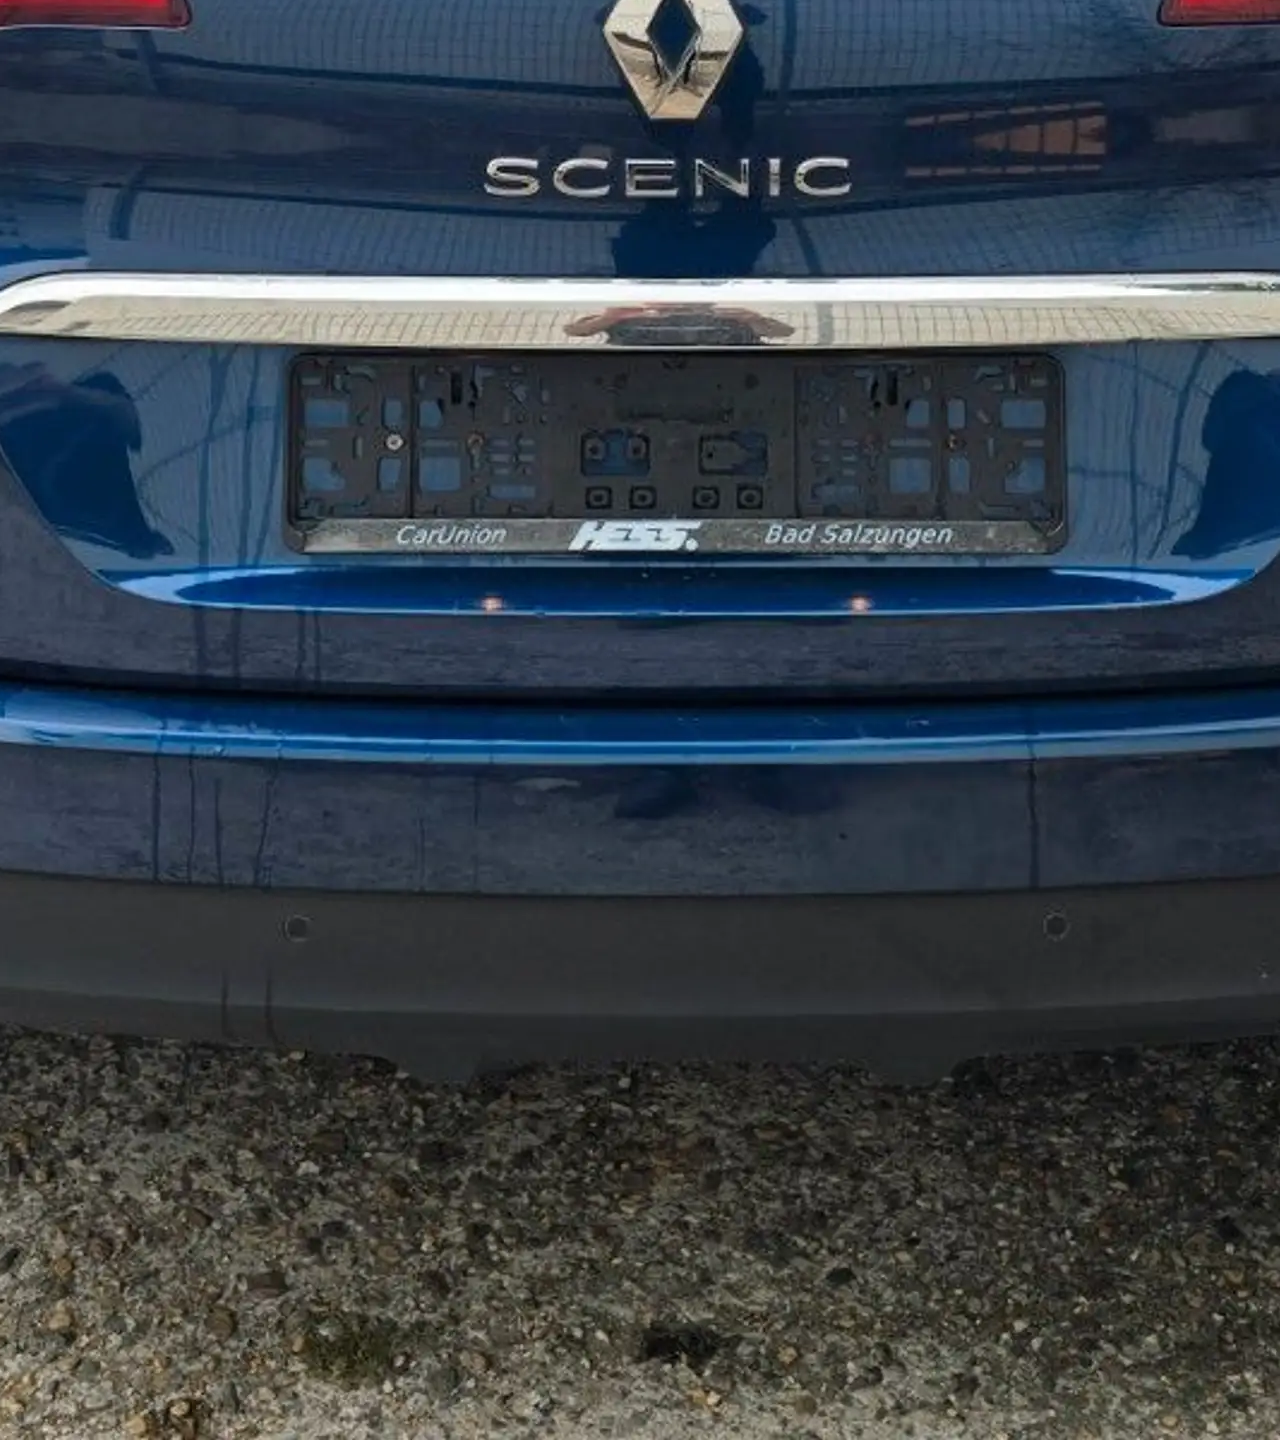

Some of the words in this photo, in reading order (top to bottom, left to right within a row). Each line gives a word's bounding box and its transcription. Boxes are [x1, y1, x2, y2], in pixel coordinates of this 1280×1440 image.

[484, 157, 851, 197] SCENIC
[395, 525, 508, 546] CarUnion
[764, 525, 811, 545] Bad
[823, 524, 954, 550] Salzungen
